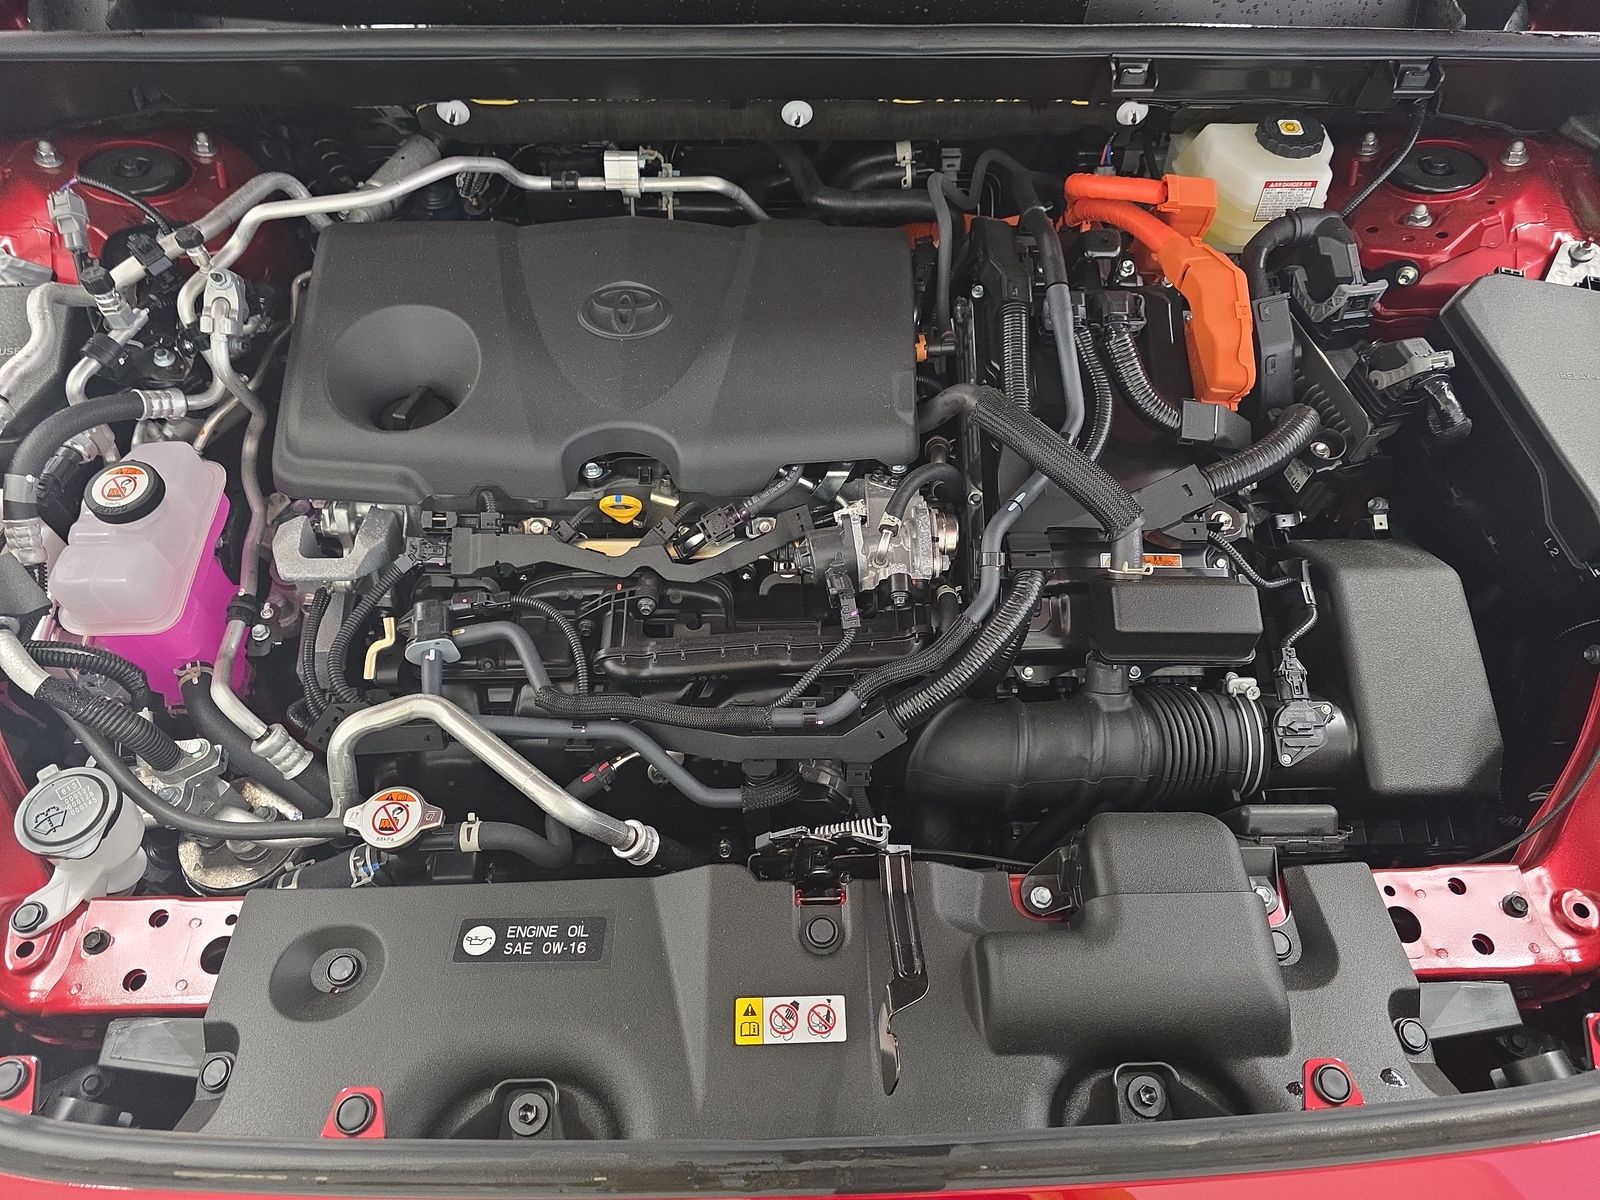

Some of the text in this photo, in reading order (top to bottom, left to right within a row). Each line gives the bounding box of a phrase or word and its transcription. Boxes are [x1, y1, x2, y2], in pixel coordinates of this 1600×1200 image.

[1543, 537, 1560, 558] L2
[64, 785, 91, 804] 000127
[506, 925, 589, 938] ENGINE OIL
[503, 941, 587, 955] SAE 0W-16
